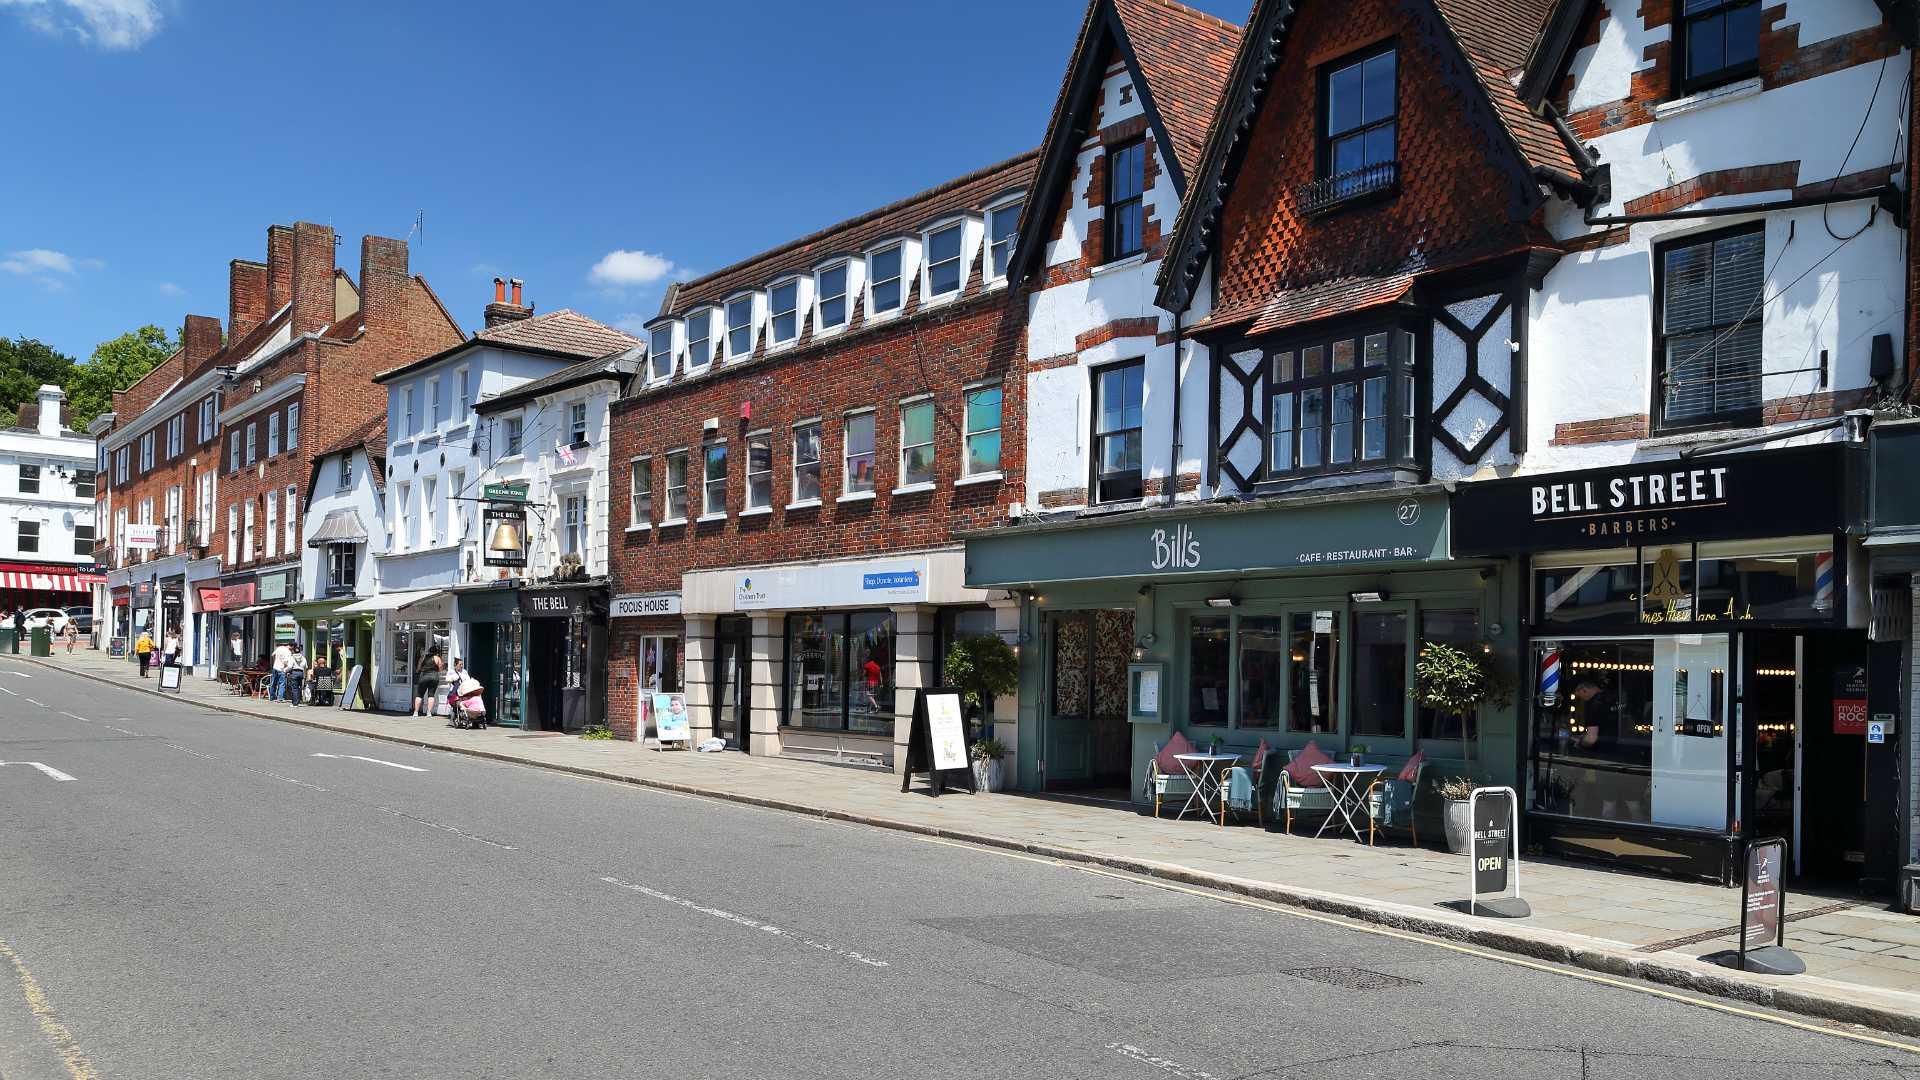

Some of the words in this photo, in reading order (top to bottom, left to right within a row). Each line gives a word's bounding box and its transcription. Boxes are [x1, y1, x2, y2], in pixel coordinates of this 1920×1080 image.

[1532, 482, 1599, 515] BELL
[1609, 468, 1727, 508] STREET
[1400, 504, 1417, 520] 27
[1589, 517, 1669, 536] BARBERS
[1151, 523, 1201, 570] Bill's
[1299, 552, 1321, 563] CAFE
[1326, 548, 1386, 561] RESTAURANT
[1394, 547, 1413, 557] BAR
[532, 597, 548, 611] THE
[550, 596, 569, 610] BELL
[619, 602, 643, 614] FOCUS
[644, 599, 669, 612] HOUSE
[1696, 724, 1712, 734] OPEN
[1487, 829, 1506, 838] STREET
[1478, 856, 1502, 872] OPEN
